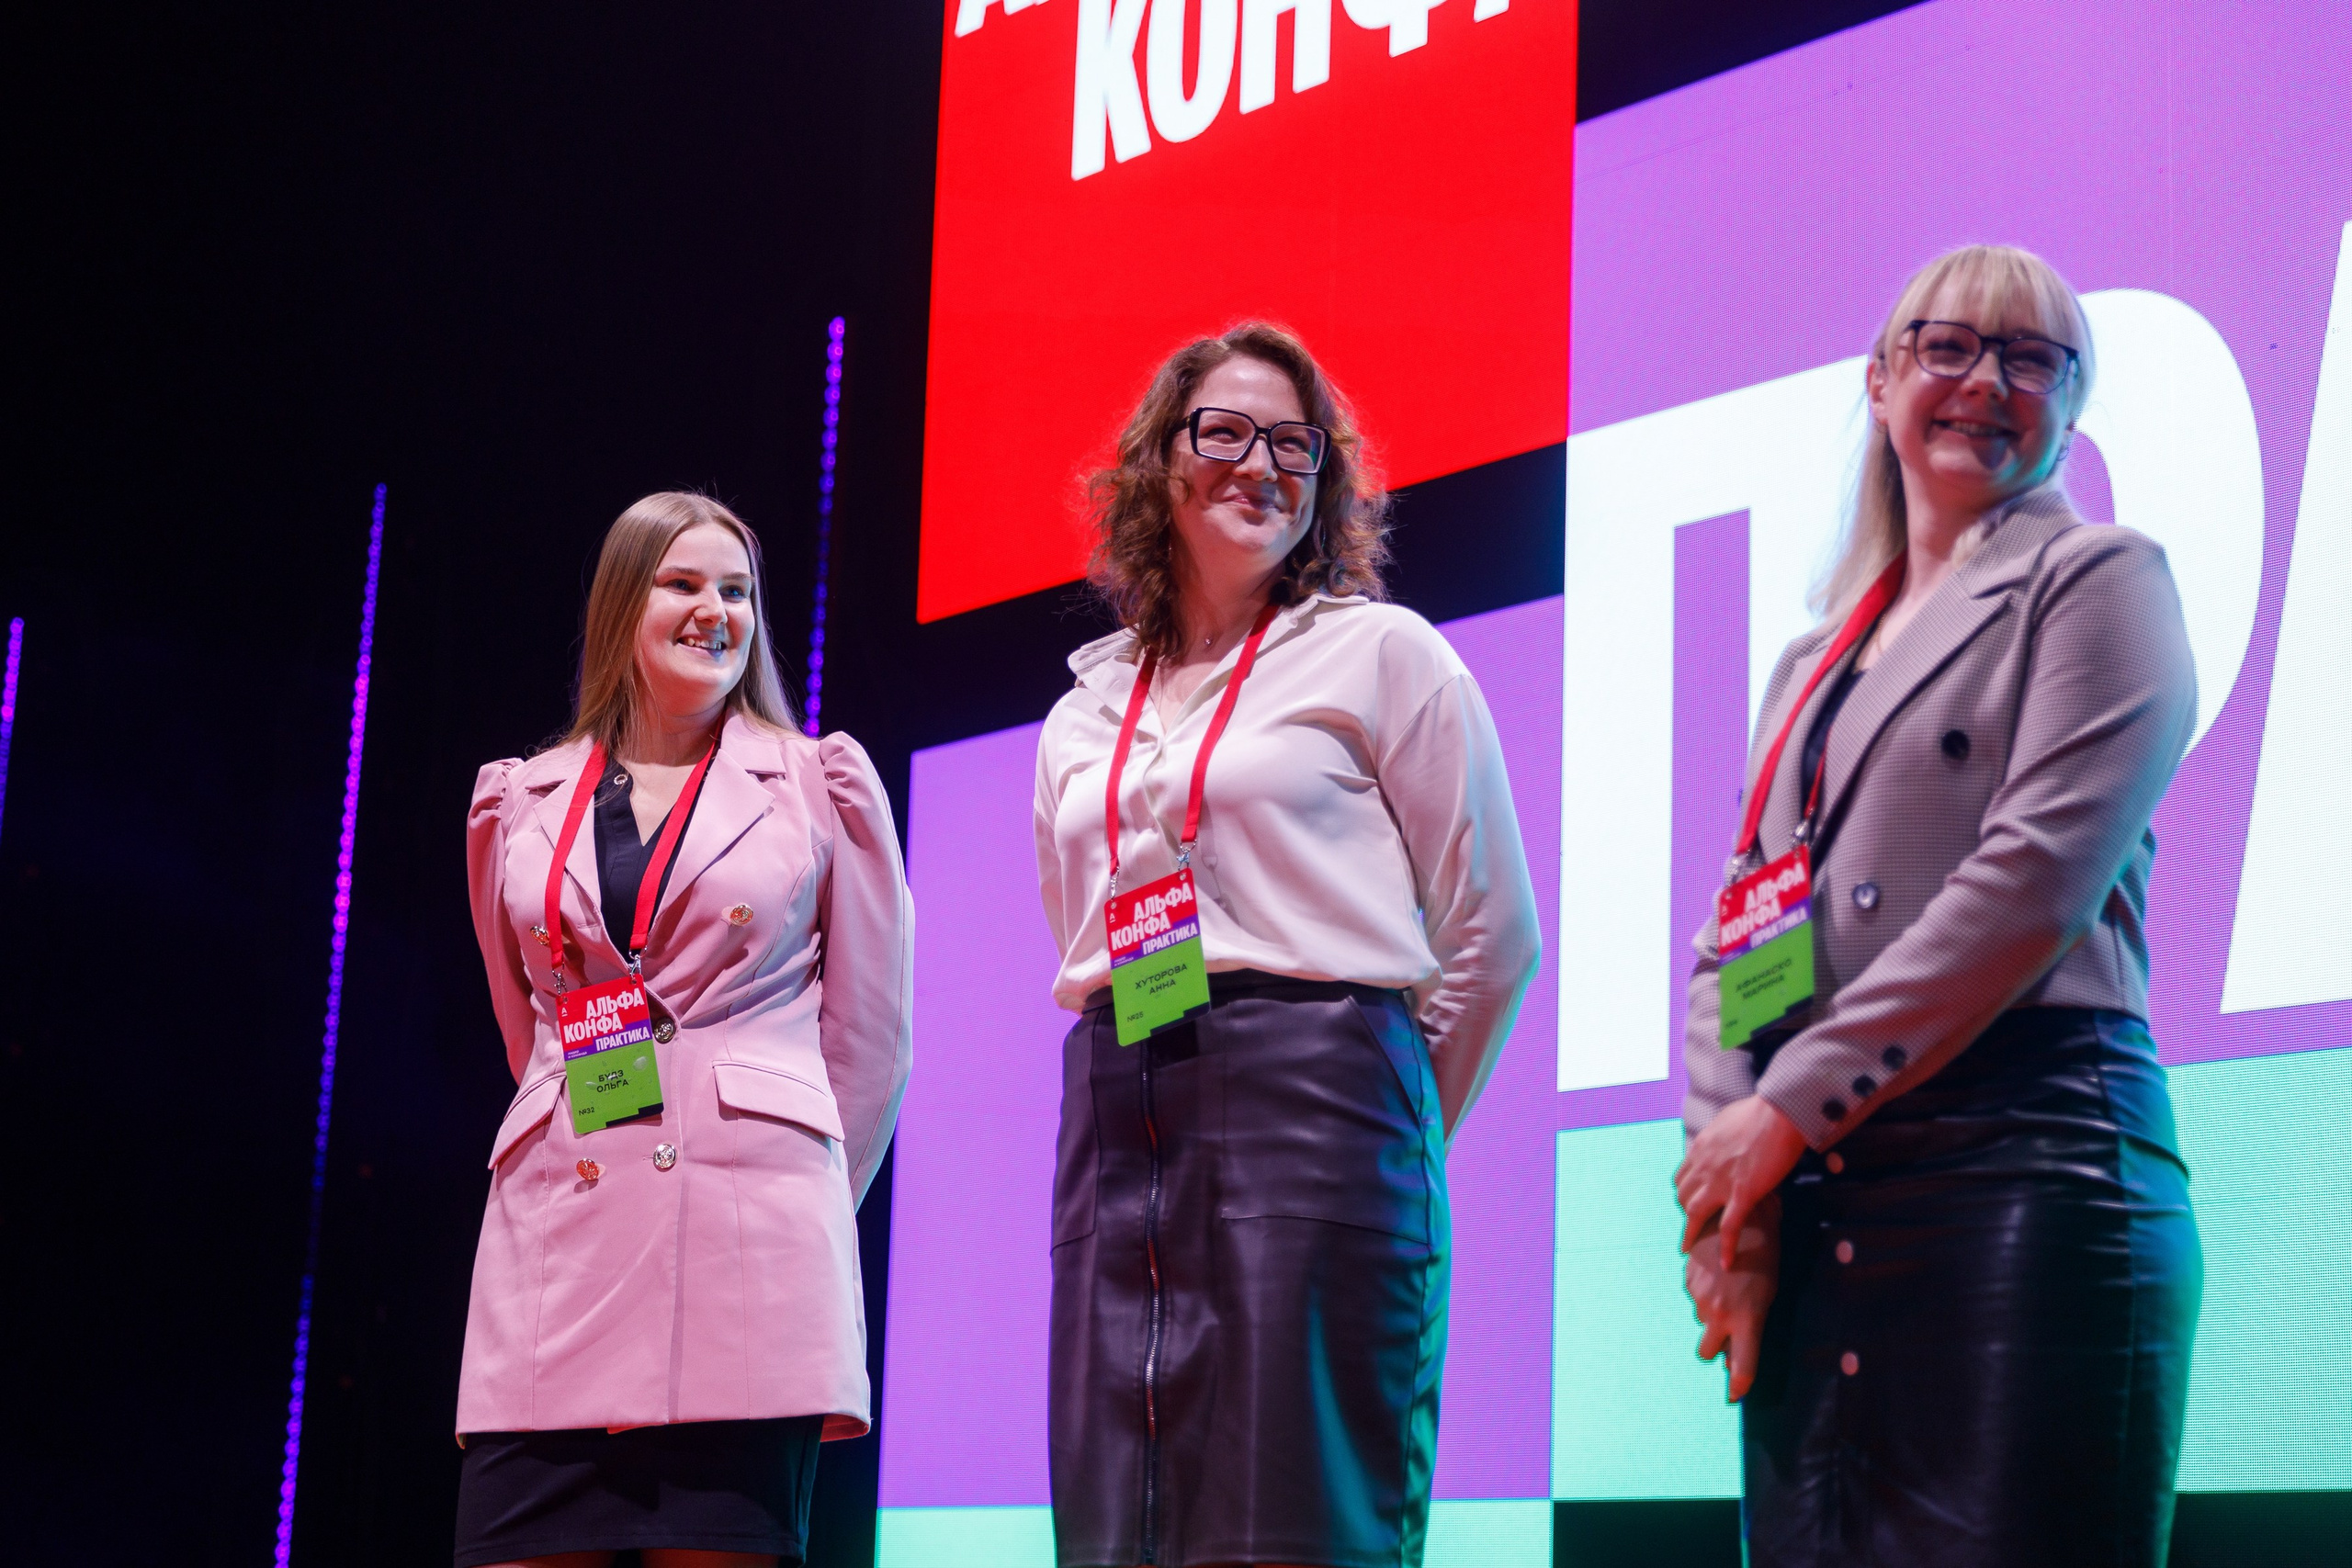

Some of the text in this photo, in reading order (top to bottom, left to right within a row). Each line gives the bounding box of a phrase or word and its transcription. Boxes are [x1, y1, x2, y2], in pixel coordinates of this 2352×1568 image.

[1071, 0, 1509, 181] КОН
[1134, 882, 1193, 922] АЛЬФА
[1744, 862, 1805, 910] АЛЬФА
[1110, 911, 1171, 951] КОНФА
[1142, 922, 1198, 955] ПРАКТИКА
[1720, 897, 1781, 947] КОНФА
[1749, 906, 1808, 949] ПРАКТИКА
[1135, 964, 1188, 990] ХУТОРОВА
[1148, 978, 1176, 996] АННА
[586, 987, 645, 1020] АЛЬФА
[563, 1012, 624, 1044] КОНФА
[595, 1026, 650, 1052] ПРАКТИКА
[596, 1080, 629, 1093] ОЛЬГА
[578, 1107, 595, 1116] №32
